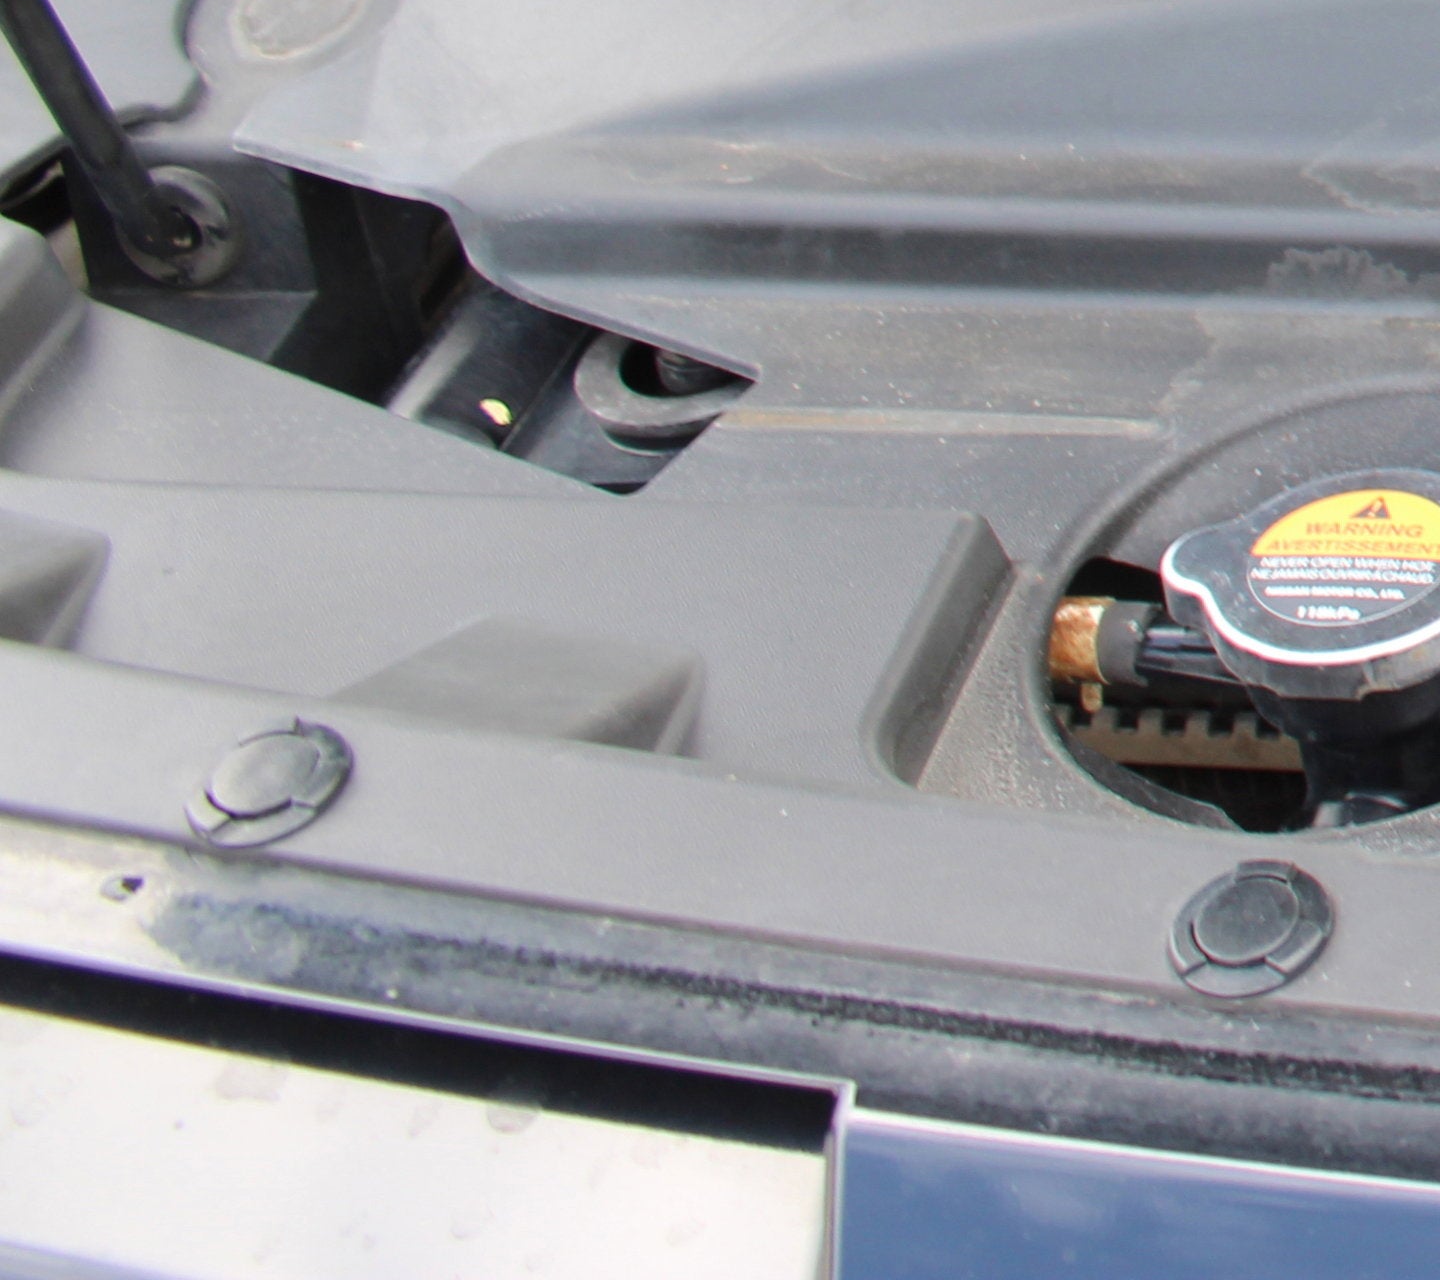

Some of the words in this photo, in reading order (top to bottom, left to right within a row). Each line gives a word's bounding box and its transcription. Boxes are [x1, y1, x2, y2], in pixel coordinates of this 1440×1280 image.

[1305, 522, 1424, 539] WARNING
[1260, 556, 1310, 568] NEVER
[1311, 556, 1353, 569] OPEN
[1355, 557, 1401, 571] WHEN
